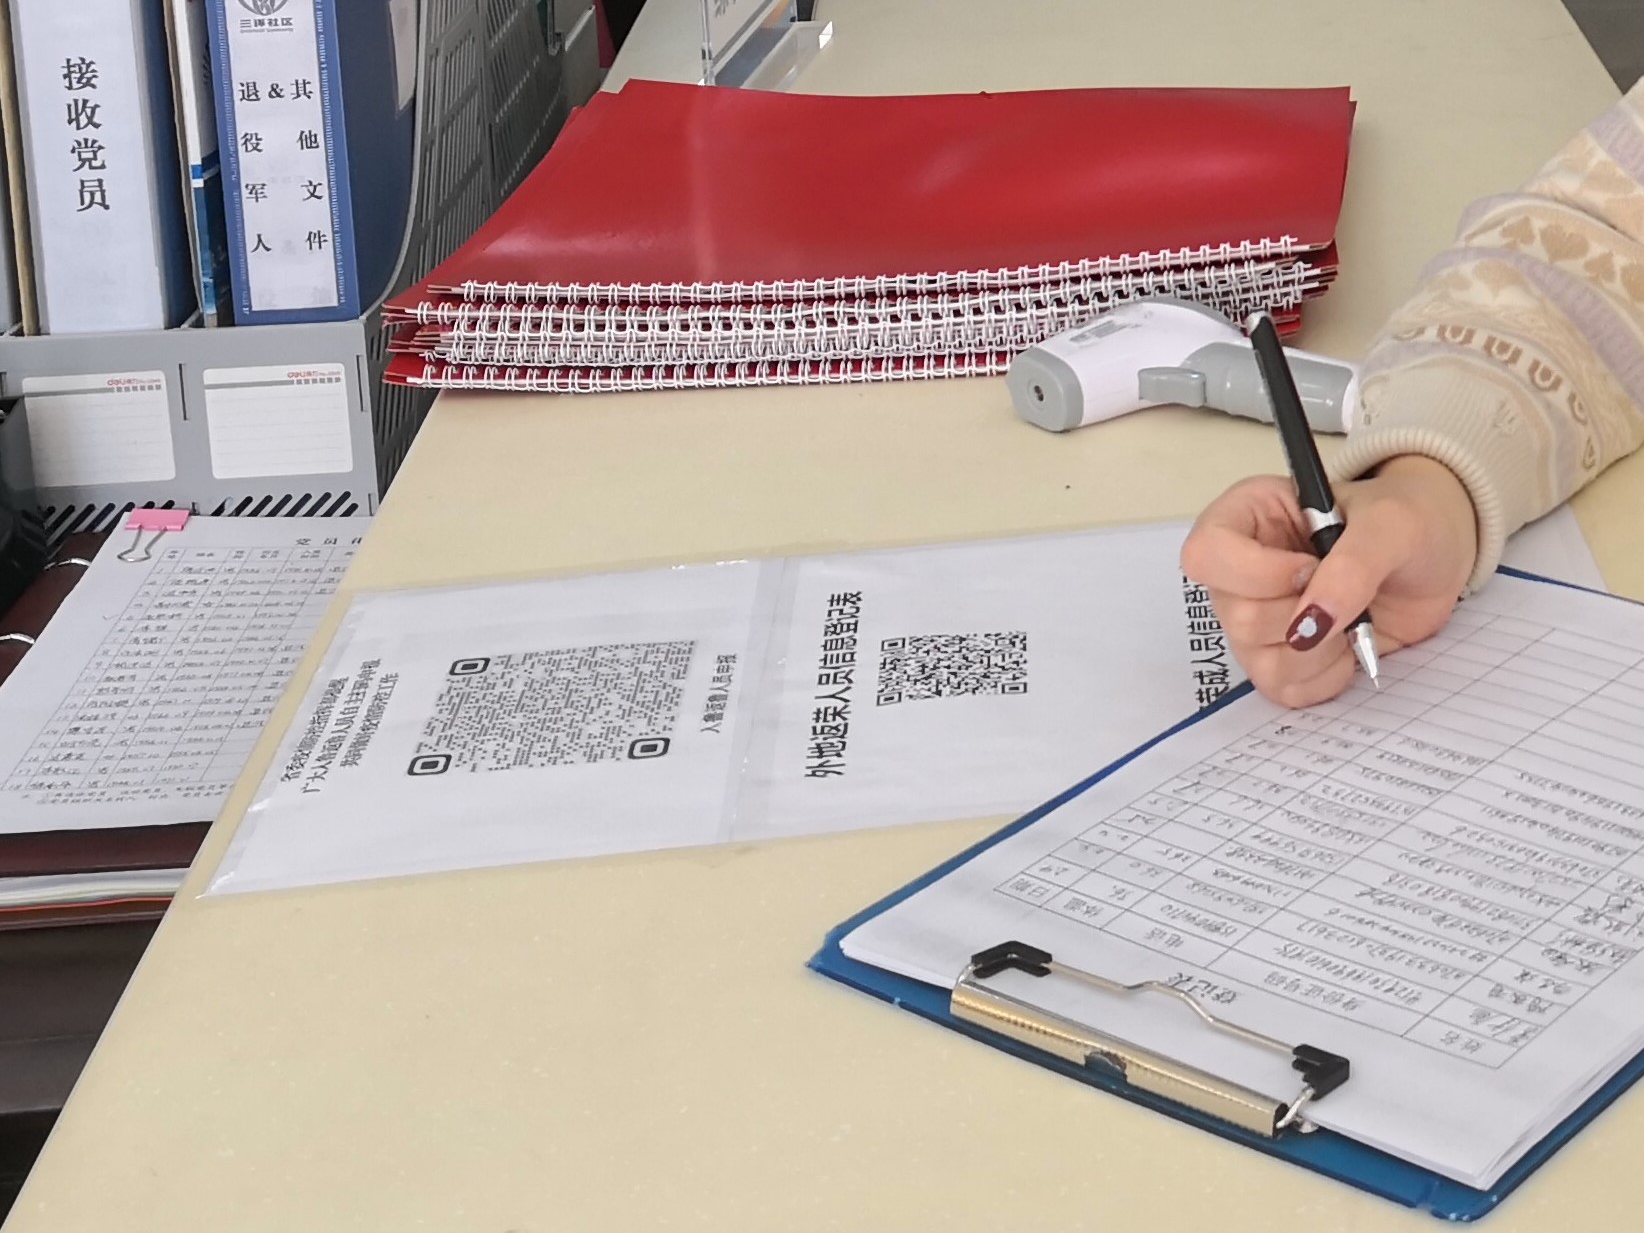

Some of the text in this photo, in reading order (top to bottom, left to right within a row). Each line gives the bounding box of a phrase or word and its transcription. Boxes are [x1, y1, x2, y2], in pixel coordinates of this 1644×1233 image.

[61, 56, 111, 213] 接收党员
[238, 80, 273, 254] 退役军人
[289, 78, 329, 251] 其他文件
[804, 590, 863, 779] 外地返荣人员信息登记表
[1262, 968, 1367, 1013] 身份证号码
